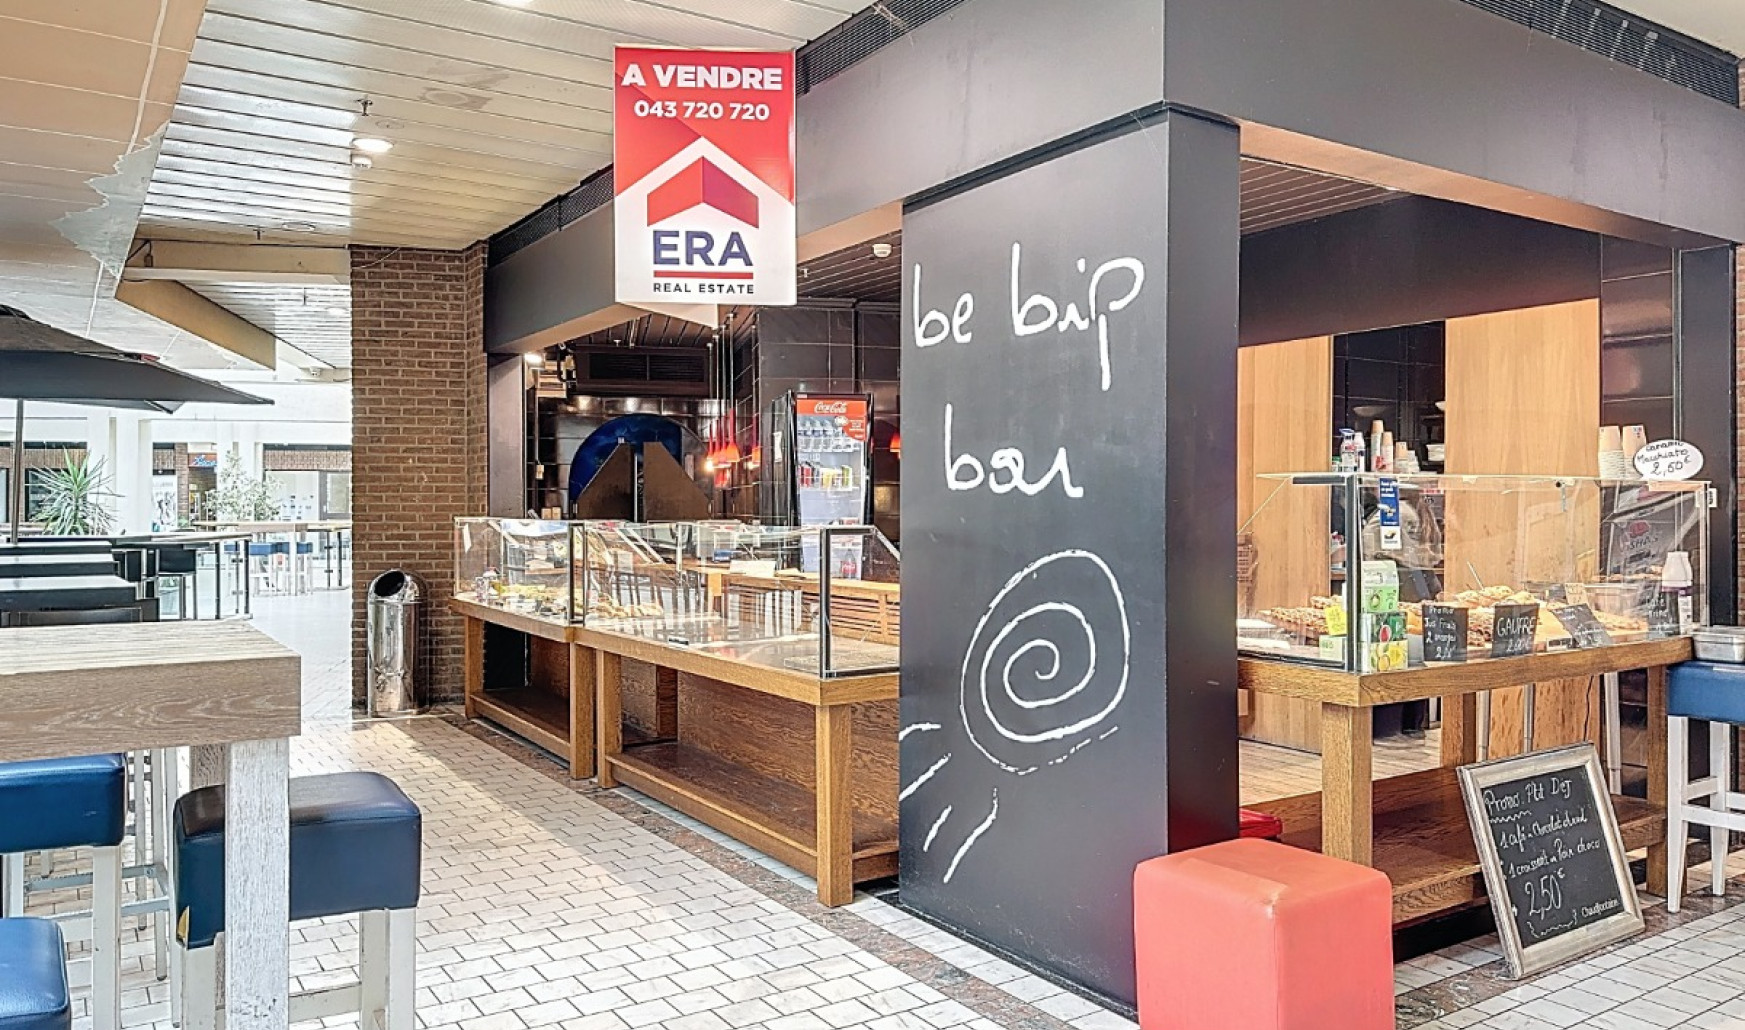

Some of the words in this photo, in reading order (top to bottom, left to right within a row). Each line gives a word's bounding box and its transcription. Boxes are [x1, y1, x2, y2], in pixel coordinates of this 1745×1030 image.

[620, 63, 647, 87] A
[652, 64, 783, 91] VENDRE
[633, 99, 677, 118] 043
[682, 101, 724, 120] 720
[729, 103, 771, 121] 720
[652, 229, 754, 267] ERA
[652, 282, 692, 293] REAL
[698, 283, 755, 294] ESTATE
[912, 262, 975, 348] be
[1011, 241, 1145, 392] bip
[944, 403, 1084, 498] bar
